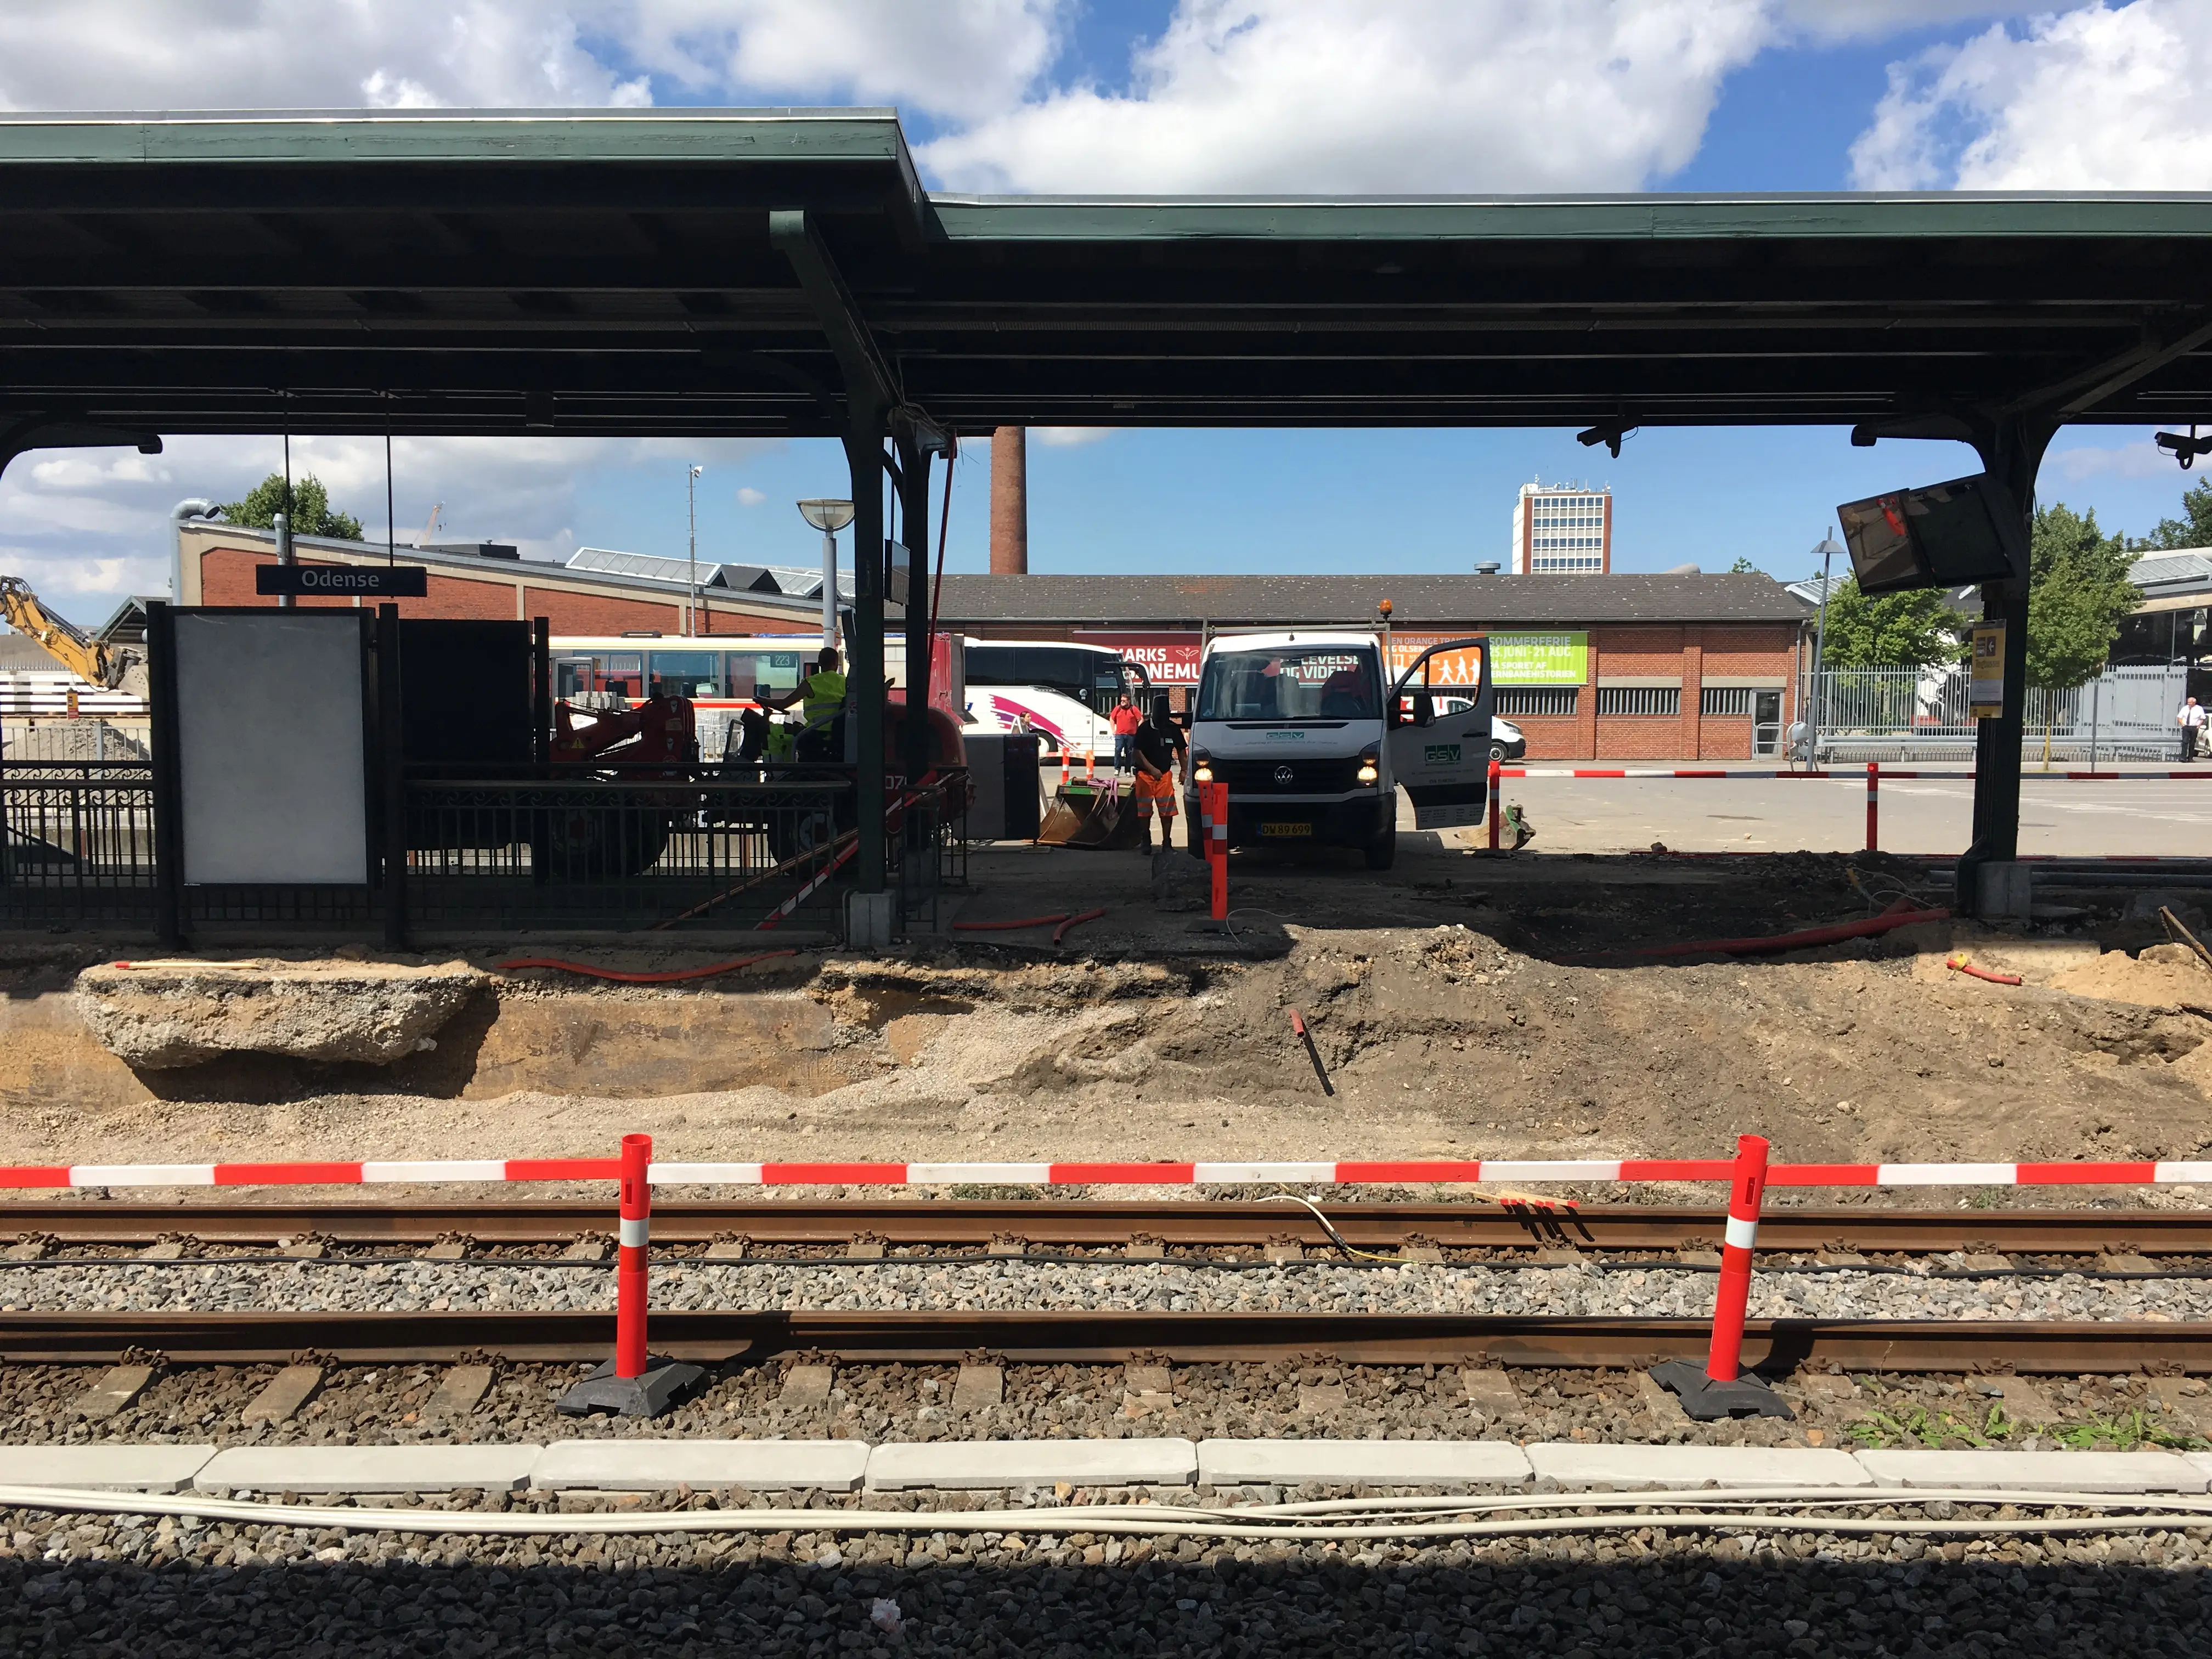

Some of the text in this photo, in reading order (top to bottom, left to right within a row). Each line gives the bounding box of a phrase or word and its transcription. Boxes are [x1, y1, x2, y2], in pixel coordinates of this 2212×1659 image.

[302, 570, 380, 587] Odense
[1404, 637, 1438, 645] ORANGE
[1489, 636, 1571, 646] SOMMERFERIE
[775, 654, 790, 666] 223
[1502, 661, 1534, 669] SPORET
[1536, 661, 1547, 669] AF
[1426, 749, 1460, 762] GSV
[1278, 825, 1290, 834] 89
[1292, 825, 1310, 834] 699
